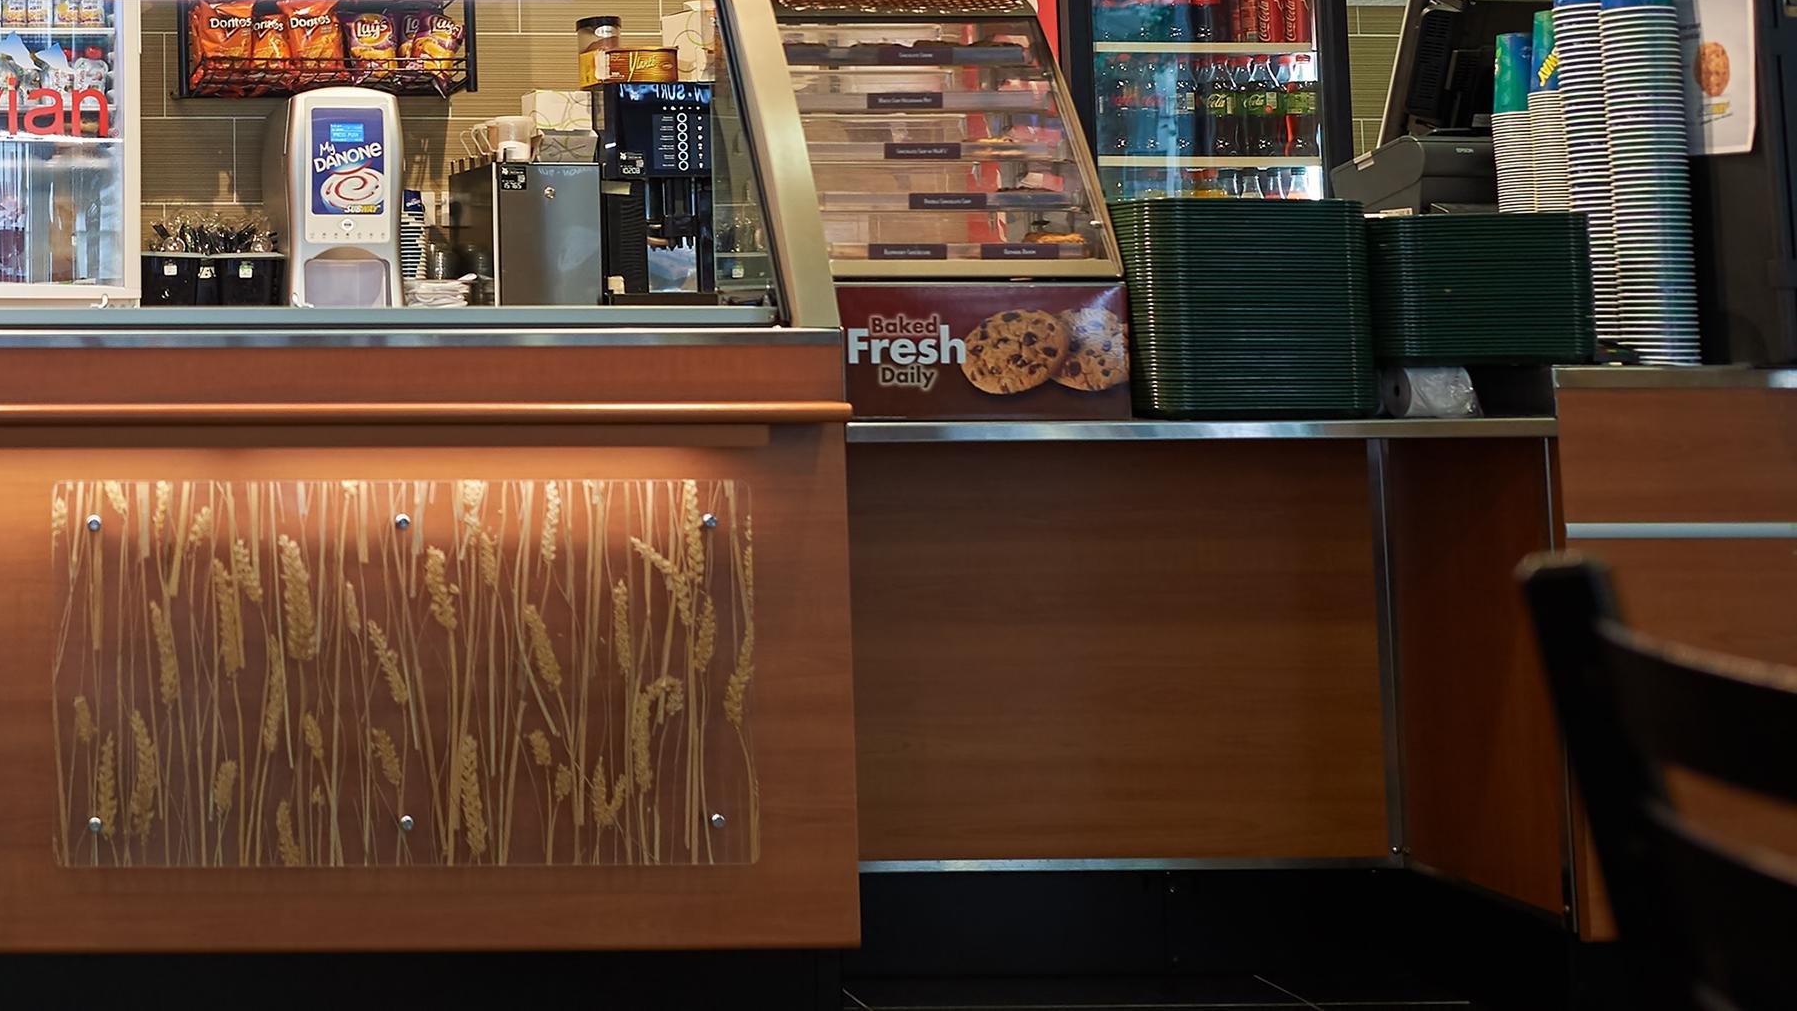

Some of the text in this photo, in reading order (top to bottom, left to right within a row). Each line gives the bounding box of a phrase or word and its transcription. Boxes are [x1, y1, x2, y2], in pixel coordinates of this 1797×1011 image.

[319, 142, 336, 157] My
[871, 317, 937, 334] Baked
[848, 325, 966, 364] Fresh
[879, 366, 935, 388] Daily
